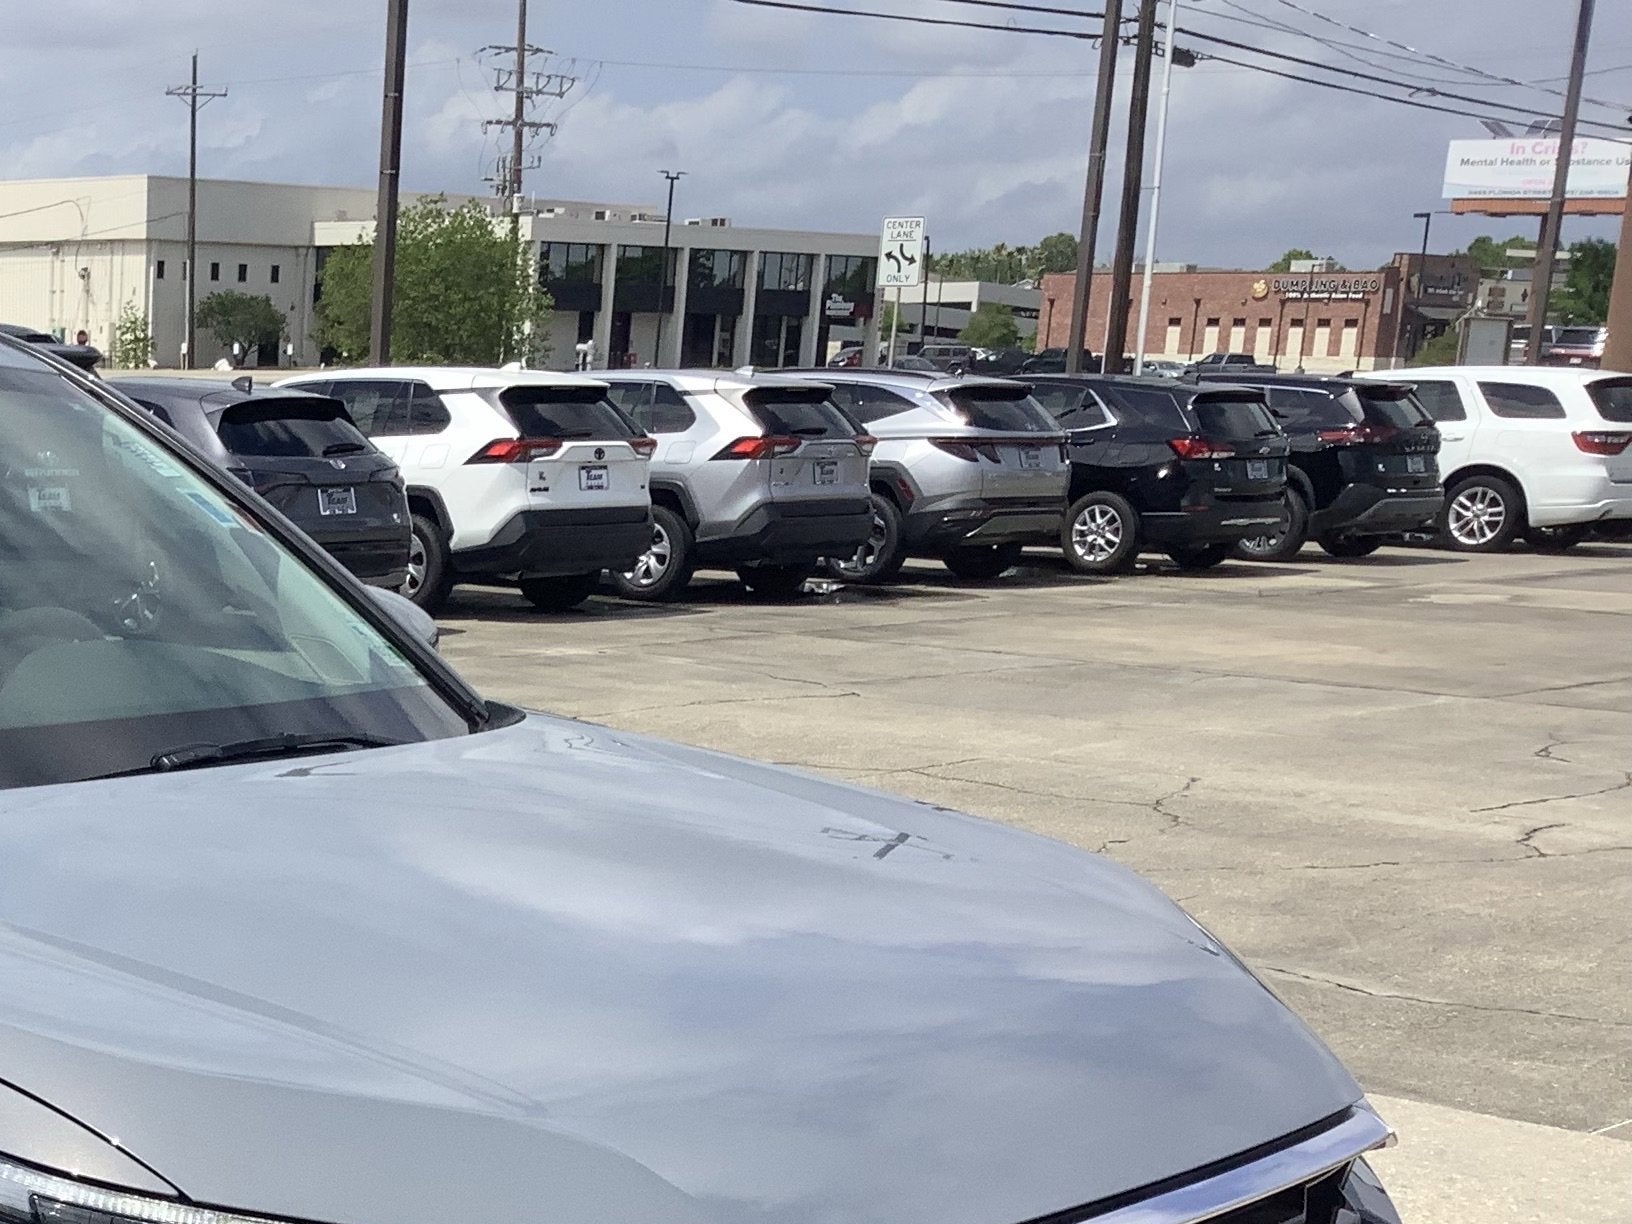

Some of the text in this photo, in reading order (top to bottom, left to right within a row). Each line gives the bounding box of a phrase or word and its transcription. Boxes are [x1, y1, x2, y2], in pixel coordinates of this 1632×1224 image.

[1510, 142, 1588, 155] In Cris?
[1460, 157, 1498, 167] Mental
[1501, 157, 1536, 166] Health
[886, 220, 921, 230] CENTER
[891, 230, 914, 239] LANE
[886, 274, 910, 283] ONLY
[1340, 280, 1349, 290] &
[1353, 280, 1379, 291] BAO
